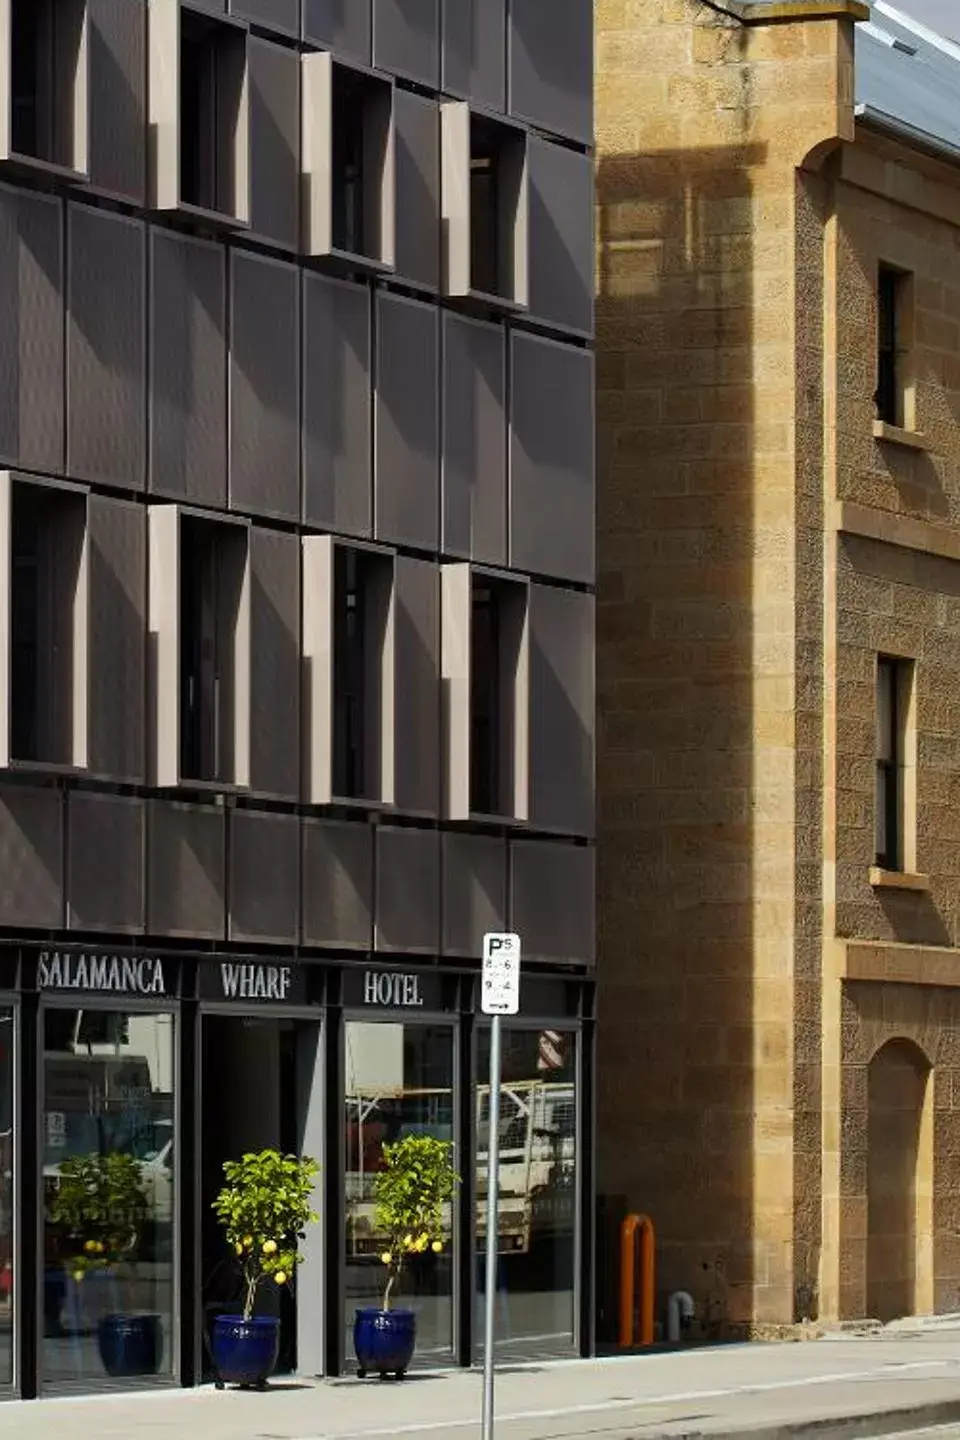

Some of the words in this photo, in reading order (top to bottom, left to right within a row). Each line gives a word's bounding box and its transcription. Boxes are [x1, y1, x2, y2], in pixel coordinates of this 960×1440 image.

[36, 951, 165, 994] SALAMANCA
[220, 962, 292, 1000] WHARF
[363, 970, 425, 1006] HOTEL
